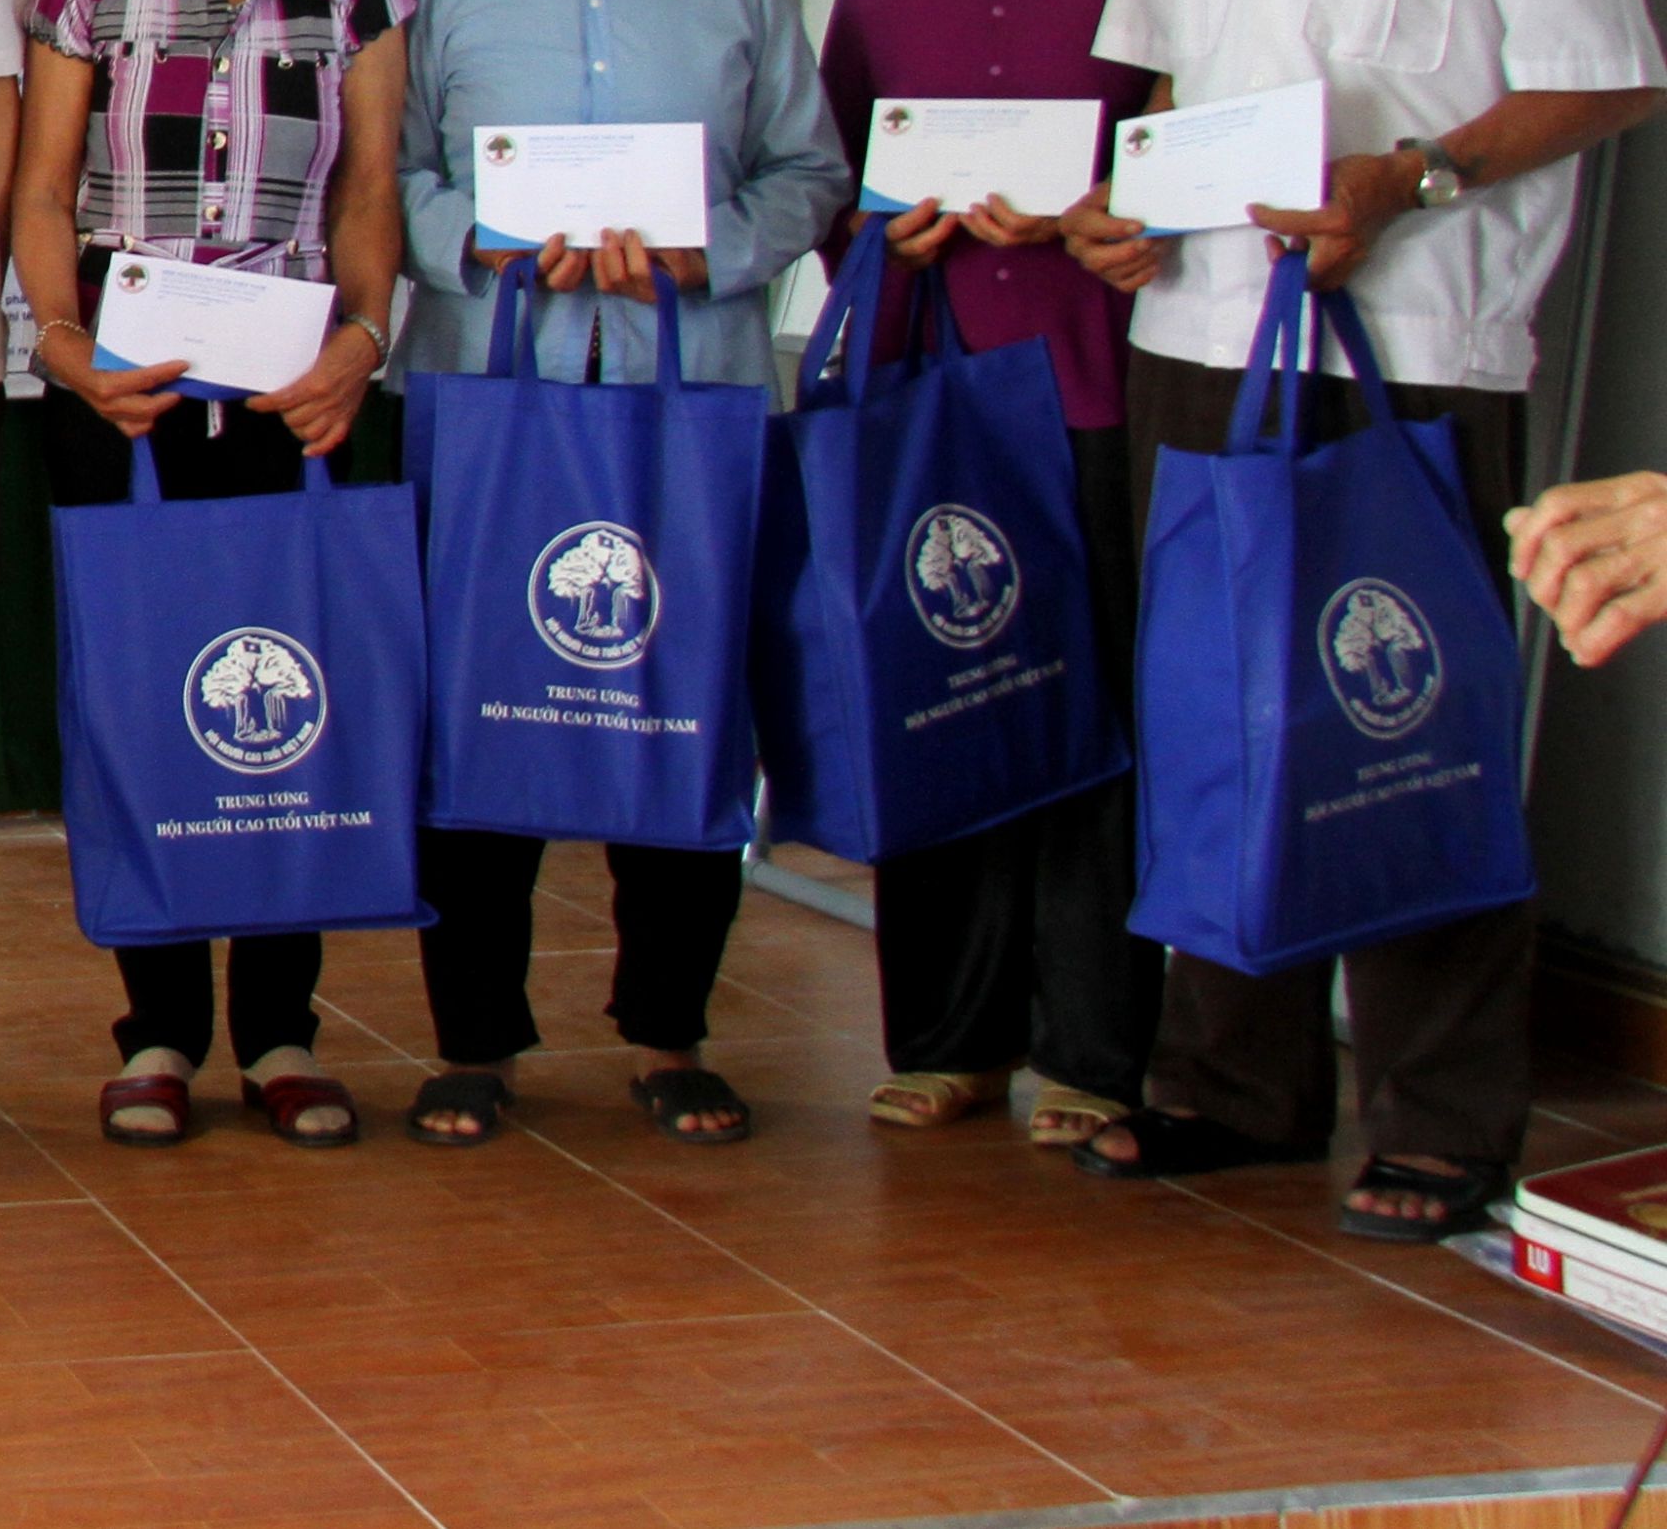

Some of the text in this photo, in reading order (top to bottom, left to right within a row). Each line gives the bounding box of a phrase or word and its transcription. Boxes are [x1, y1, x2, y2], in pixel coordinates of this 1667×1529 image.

[545, 684, 597, 702] TRUNG
[480, 700, 508, 720] HỘI
[511, 704, 559, 723] NGƯỜI
[562, 709, 592, 725] CAO
[663, 719, 698, 734] NAM
[215, 791, 309, 809] TRUNG ƯƠNG
[156, 810, 371, 839] HỘI NGƯỜI CAO TUỔI VIỆT NAM
